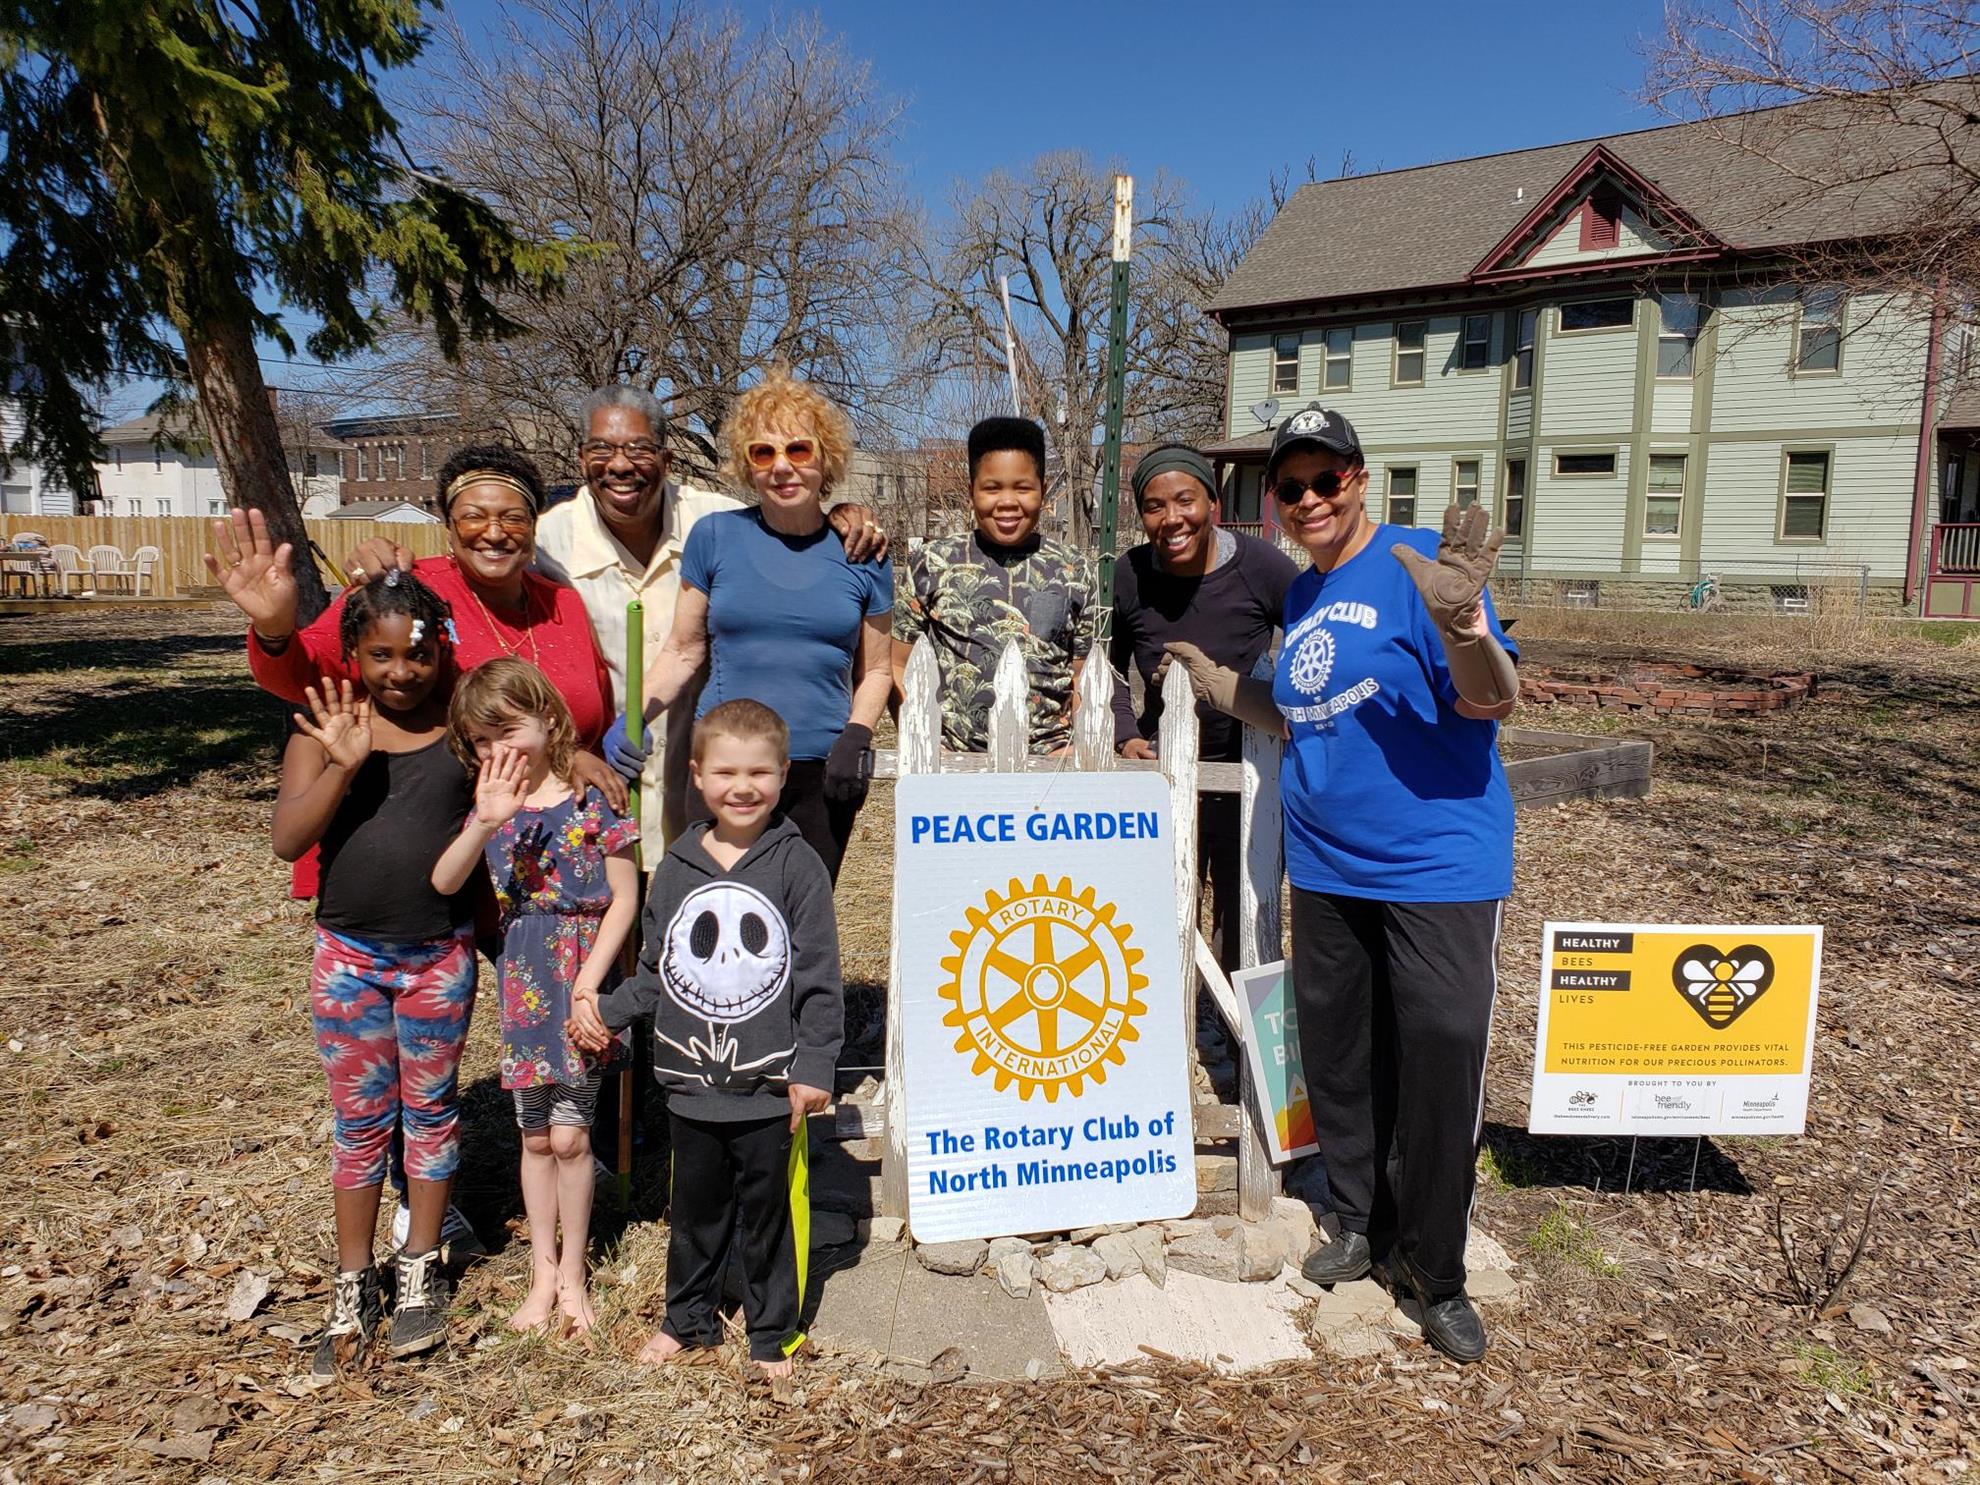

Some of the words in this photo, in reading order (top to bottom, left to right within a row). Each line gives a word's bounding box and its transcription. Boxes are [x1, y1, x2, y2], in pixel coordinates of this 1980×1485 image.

[1328, 601, 1378, 630] CLUB
[911, 814, 1015, 844] PEACE
[1026, 812, 1159, 842] GARDEN
[1000, 899, 1084, 926] ROTARY
[1562, 938, 1620, 948] HEALTHY
[1562, 957, 1593, 966] BEES
[1560, 976, 1617, 986] HEALTHY
[1559, 995, 1594, 1004] LIVES
[976, 1018, 1121, 1077] INTERNATIONAL
[1273, 1040, 1301, 1065] BI
[1563, 1043, 1585, 1051] THIS
[1589, 1043, 1667, 1052] PESTICIDE-FREE
[1671, 1044, 1710, 1052] GARDEN
[1714, 1044, 1760, 1052] PROVIDES
[1764, 1043, 1789, 1051] VITAL
[1561, 1058, 1616, 1066] NUTRITION
[1620, 1058, 1639, 1066] FOR
[1643, 1058, 1664, 1066] OUR
[1668, 1058, 1717, 1066] PRECIOUS
[1720, 1058, 1788, 1066] POLLINATORS.
[1655, 1094, 1672, 1103] bee
[1657, 1100, 1692, 1111] friendly
[926, 1130, 975, 1156] The
[985, 1122, 1074, 1154] Rotary
[1082, 1114, 1139, 1142] Club
[1148, 1111, 1175, 1136] of
[929, 1163, 1008, 1194] North
[1017, 1150, 1177, 1187] Minneapolis
